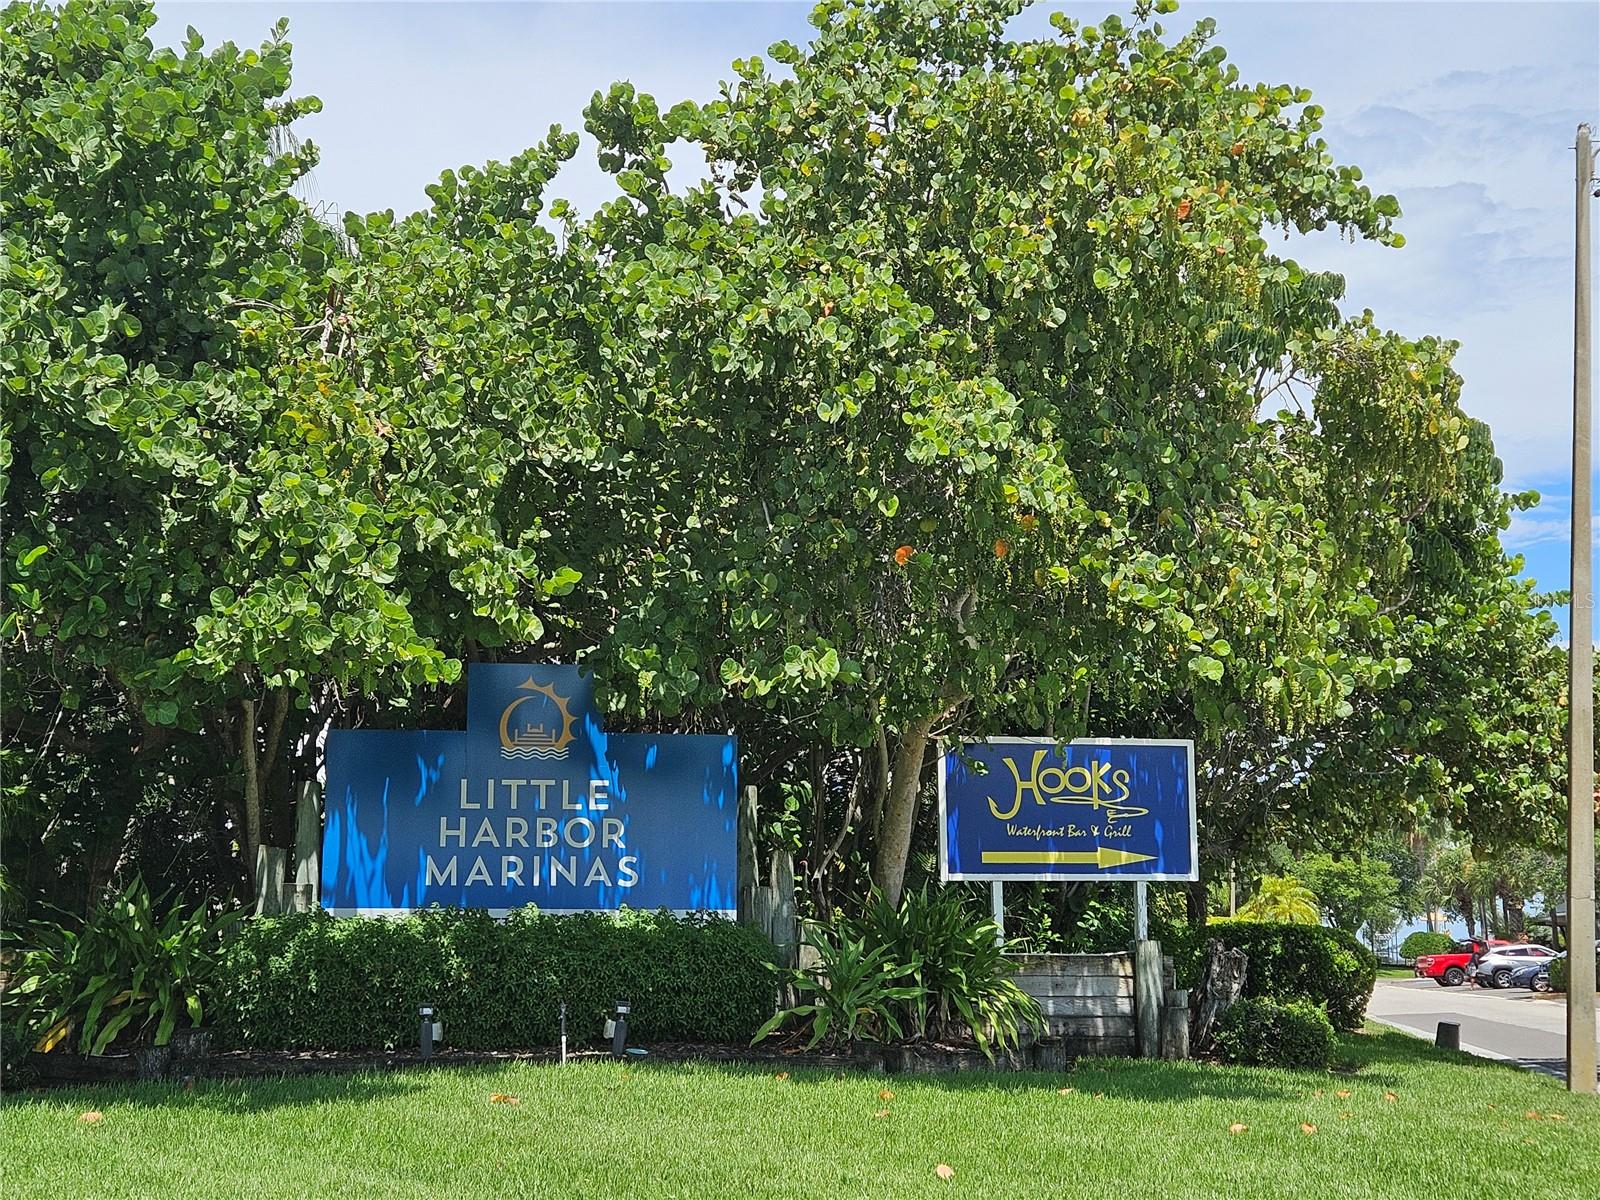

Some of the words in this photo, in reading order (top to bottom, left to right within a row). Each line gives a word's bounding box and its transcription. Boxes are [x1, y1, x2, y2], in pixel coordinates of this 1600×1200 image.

[460, 778, 610, 810] LITTLE
[438, 816, 626, 849] HARBOR
[1006, 823, 1065, 841] Waterfront
[1067, 824, 1087, 837] Bar
[1090, 825, 1100, 837] &
[1104, 824, 1132, 838] Grill
[425, 855, 639, 888] MARINAS
